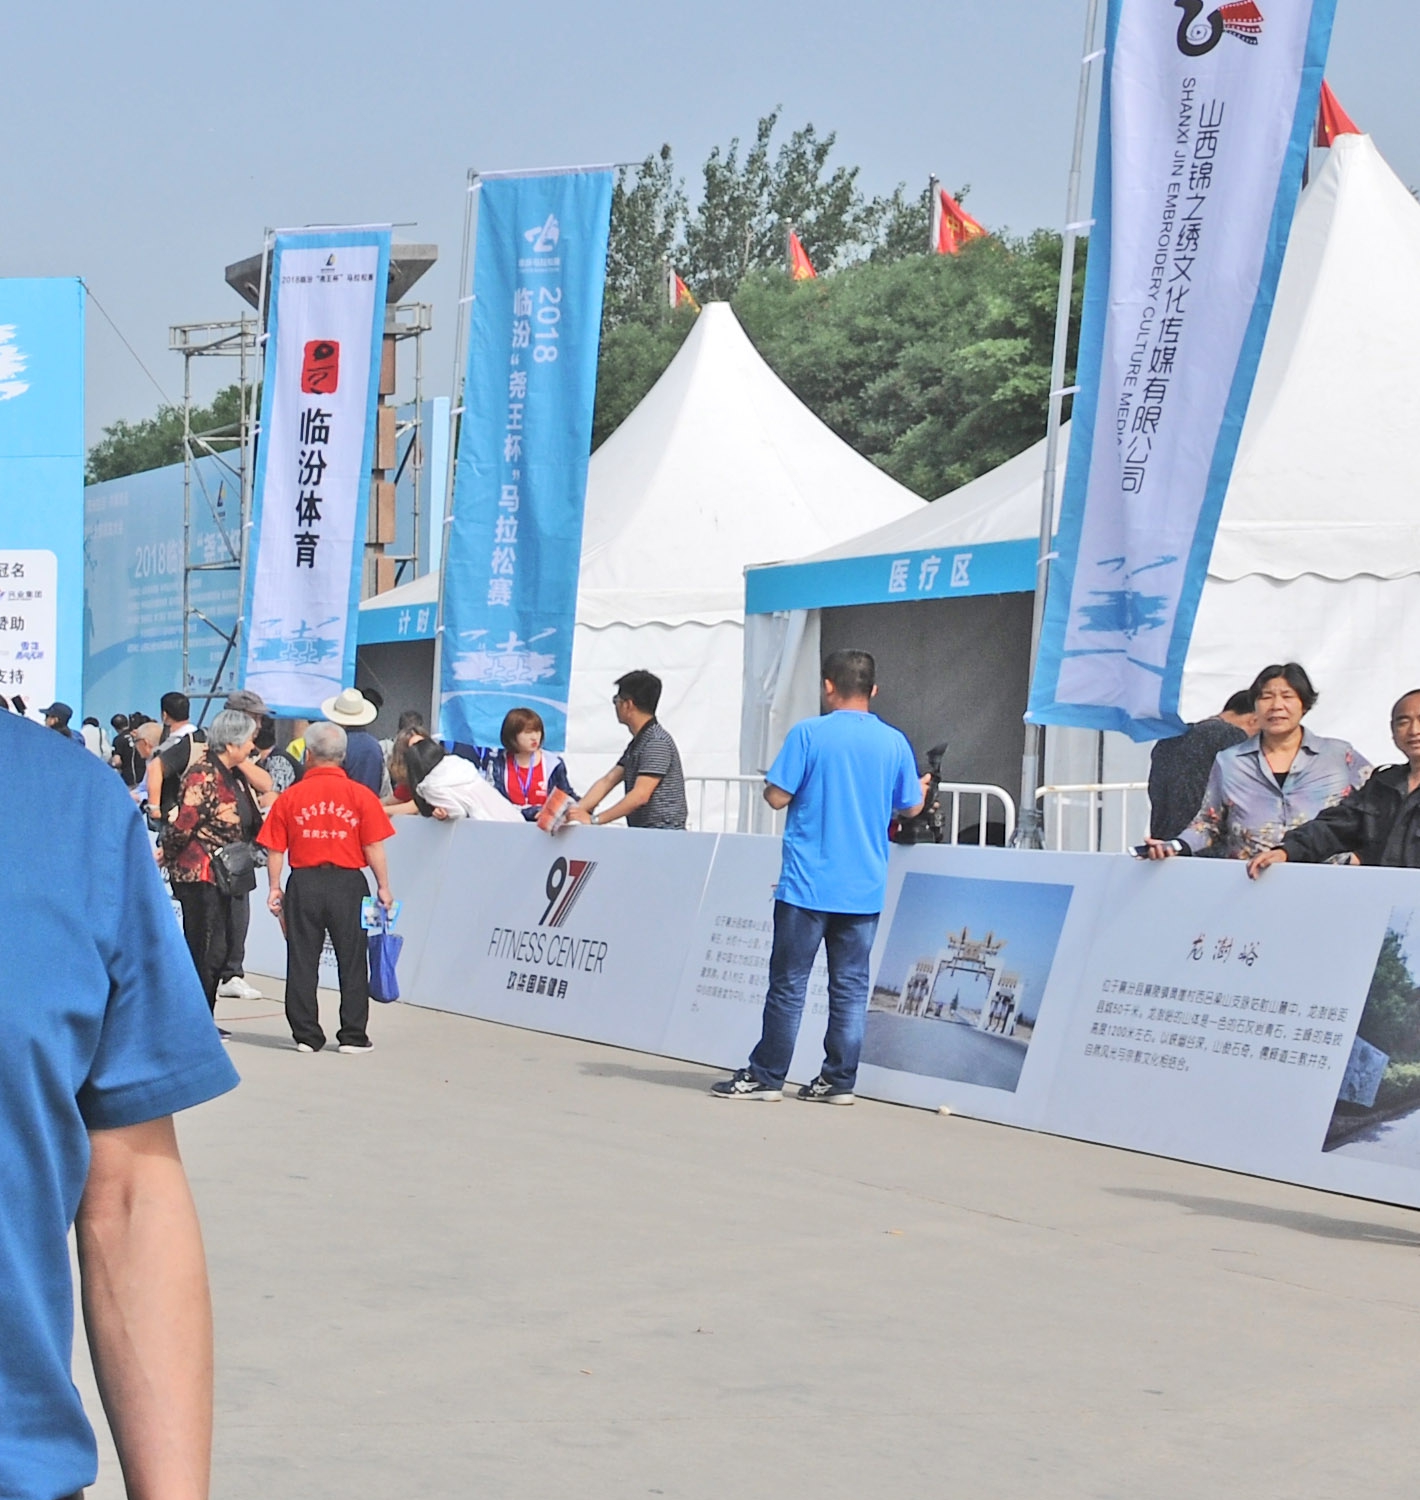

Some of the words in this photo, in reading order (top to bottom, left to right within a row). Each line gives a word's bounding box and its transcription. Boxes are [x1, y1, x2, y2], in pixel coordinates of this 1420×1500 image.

[1176, 77, 1196, 144] SHANXI
[1170, 150, 1185, 177] JIN
[1148, 181, 1181, 302] EMBROIDERY
[532, 287, 562, 363] 2018
[1121, 98, 1225, 495] 山西锦之绣文化传媒有限公司
[1123, 306, 1156, 387] CULTURE
[294, 407, 333, 569] 临汾体育
[888, 552, 973, 593] 医疗区
[398, 607, 440, 635] 计时
[538, 856, 598, 927] 97
[487, 927, 544, 965] FITNESS
[545, 934, 608, 974] CENTER
